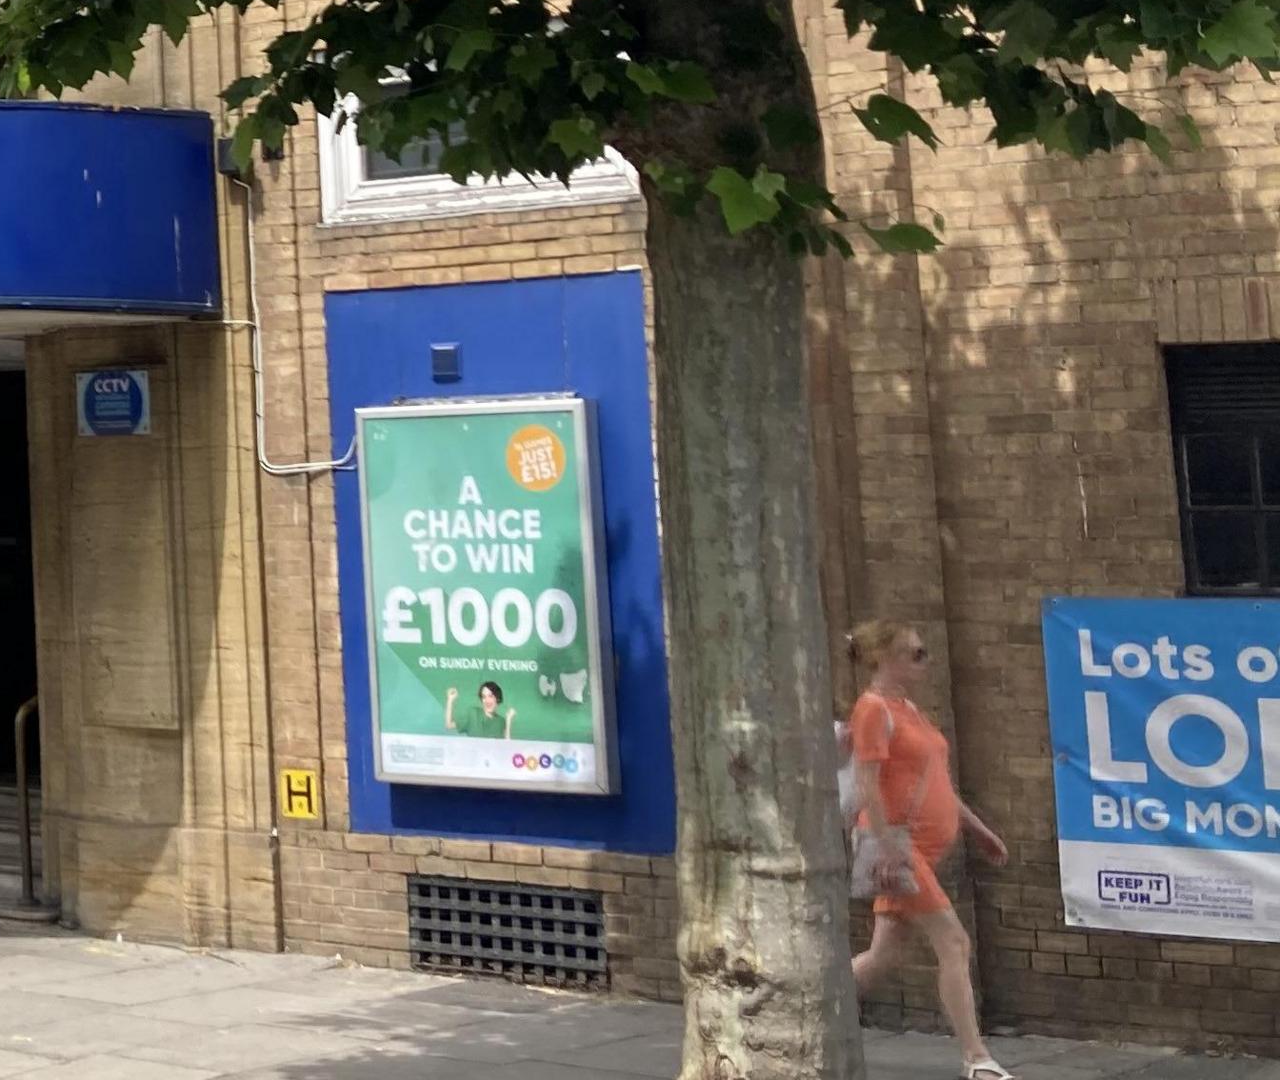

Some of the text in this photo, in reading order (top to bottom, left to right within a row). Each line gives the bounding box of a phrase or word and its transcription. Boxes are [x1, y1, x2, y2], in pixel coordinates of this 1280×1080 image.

[94, 378, 130, 393] CCTV
[519, 446, 554, 466] JUST
[458, 475, 482, 505] A
[403, 509, 542, 539] CHANCE
[412, 544, 534, 574] TO WIN
[382, 586, 578, 648] £1000
[418, 656, 539, 673] ON SUNDAY EVENING
[1078, 629, 1280, 683] Lots o
[287, 775, 312, 813] H
[1092, 795, 1170, 831] BIG
[1104, 877, 1143, 889] KEEP
[1148, 879, 1163, 892] IT
[1119, 891, 1151, 904] FUN
